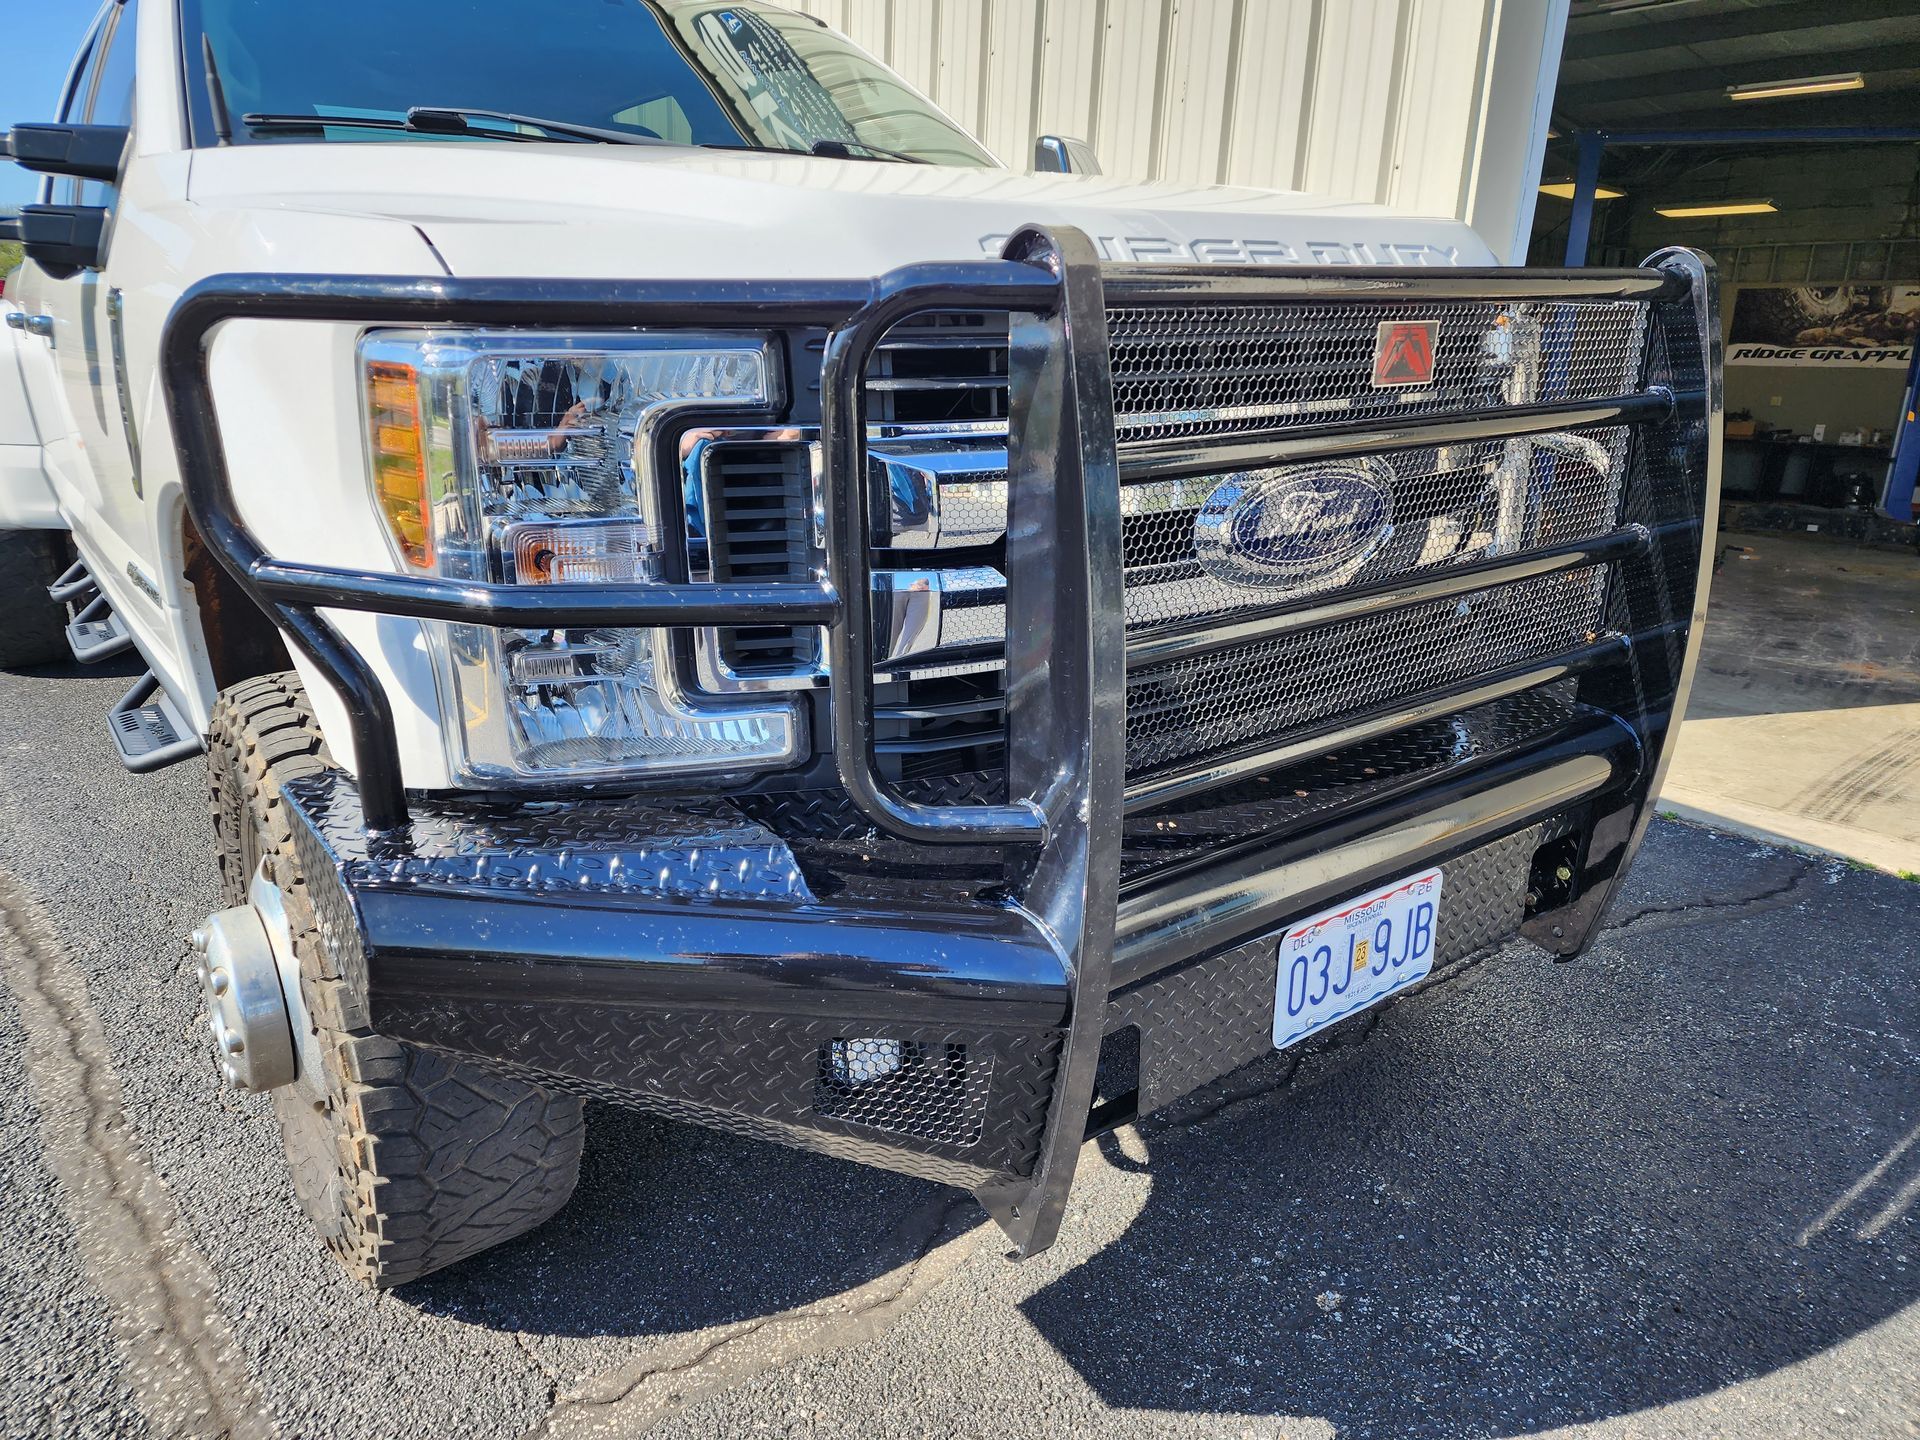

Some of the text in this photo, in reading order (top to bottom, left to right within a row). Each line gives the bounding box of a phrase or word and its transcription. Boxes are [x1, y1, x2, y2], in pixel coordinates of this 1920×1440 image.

[1732, 347, 1807, 360] RIDGE
[1343, 900, 1388, 926] MISSOURI
[1293, 929, 1315, 952] DEC
[1287, 901, 1434, 1017] 03J 9JB
[1356, 946, 1367, 962] 23
